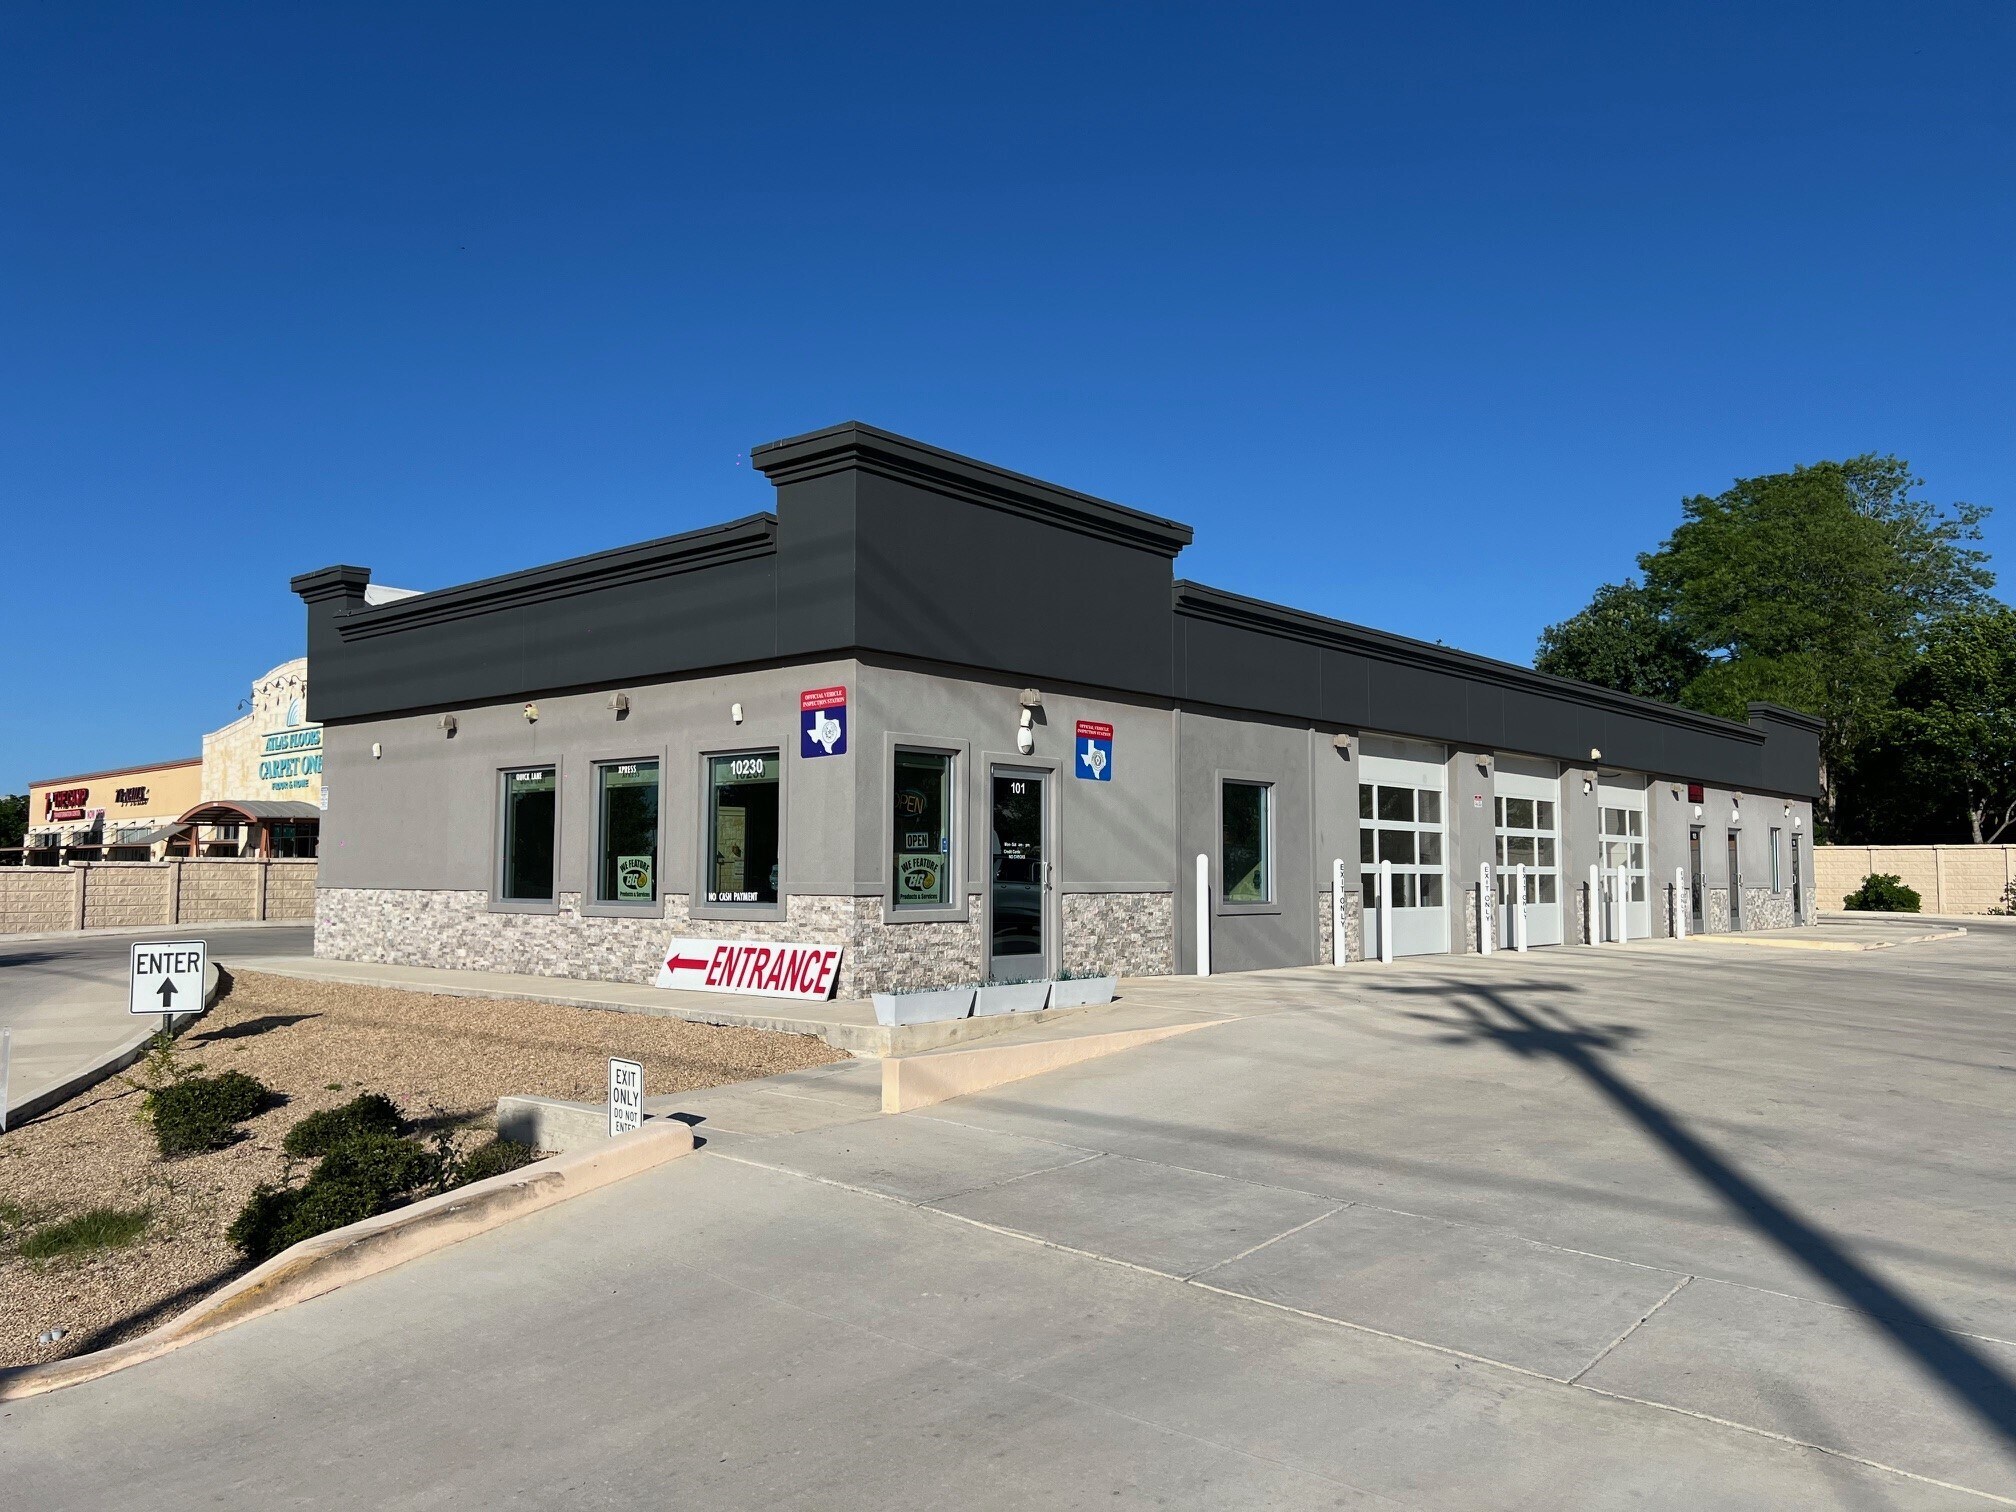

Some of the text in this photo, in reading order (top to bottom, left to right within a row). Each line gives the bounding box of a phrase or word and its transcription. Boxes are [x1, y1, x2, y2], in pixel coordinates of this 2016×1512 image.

[266, 730, 320, 752] ATLAS FLOORS
[259, 757, 300, 780] CARPET
[618, 765, 636, 774] XPRESS
[730, 758, 763, 775] 10230
[1010, 782, 1026, 794] 101
[907, 834, 928, 848] OPEN
[620, 859, 650, 872] WE FEATURE
[900, 858, 938, 874] WE FEATURE
[908, 874, 925, 887] BG
[708, 892, 758, 901] NO CASH PAYMENT
[136, 952, 200, 974] ENTER
[705, 946, 837, 994] ENTRANCE
[616, 1068, 636, 1087] EXIT
[614, 1088, 638, 1107] ONLY
[614, 1108, 637, 1122] DO NOT
